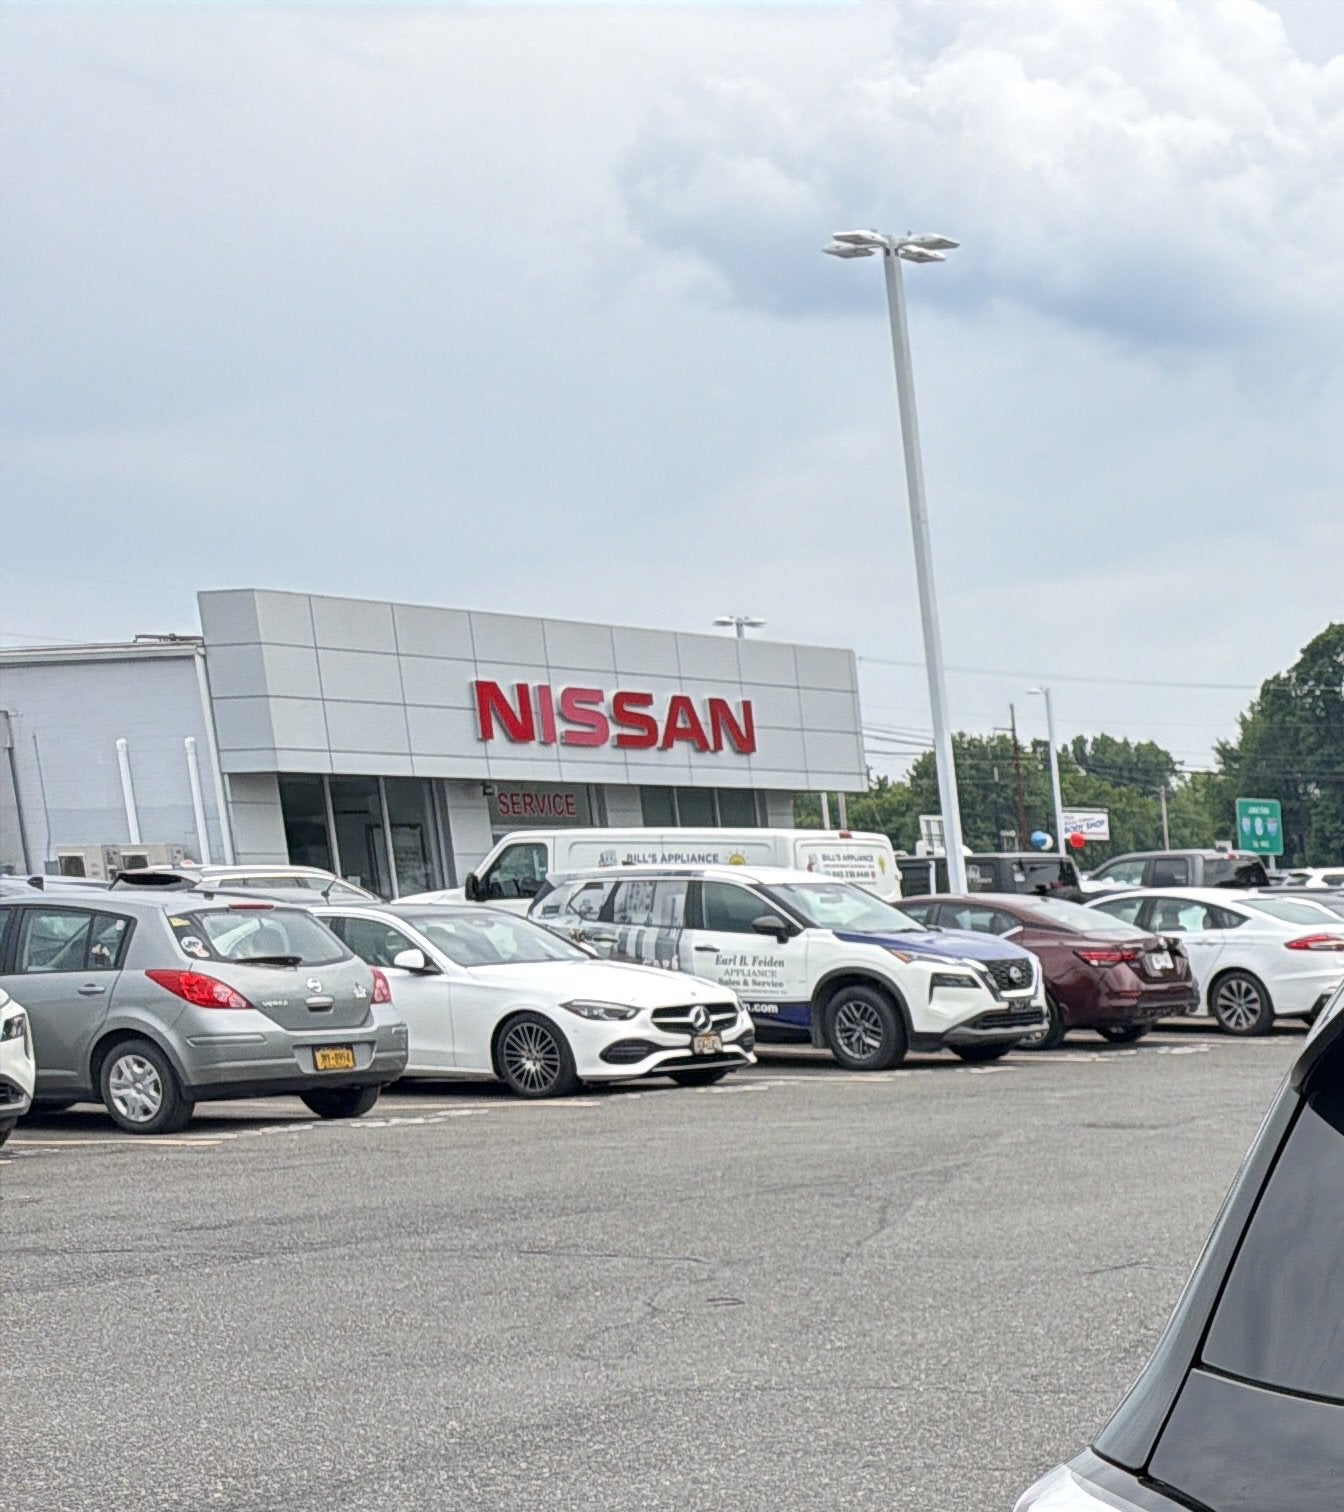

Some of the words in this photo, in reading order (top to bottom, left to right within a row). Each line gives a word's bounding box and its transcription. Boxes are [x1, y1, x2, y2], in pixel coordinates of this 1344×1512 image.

[473, 679, 757, 754] NISSAN
[498, 793, 577, 816] SERVICE
[626, 852, 658, 865] BILL'S
[660, 852, 719, 865] APPLIANCE
[715, 954, 737, 966] Earl
[723, 968, 778, 978] APPLIANCE
